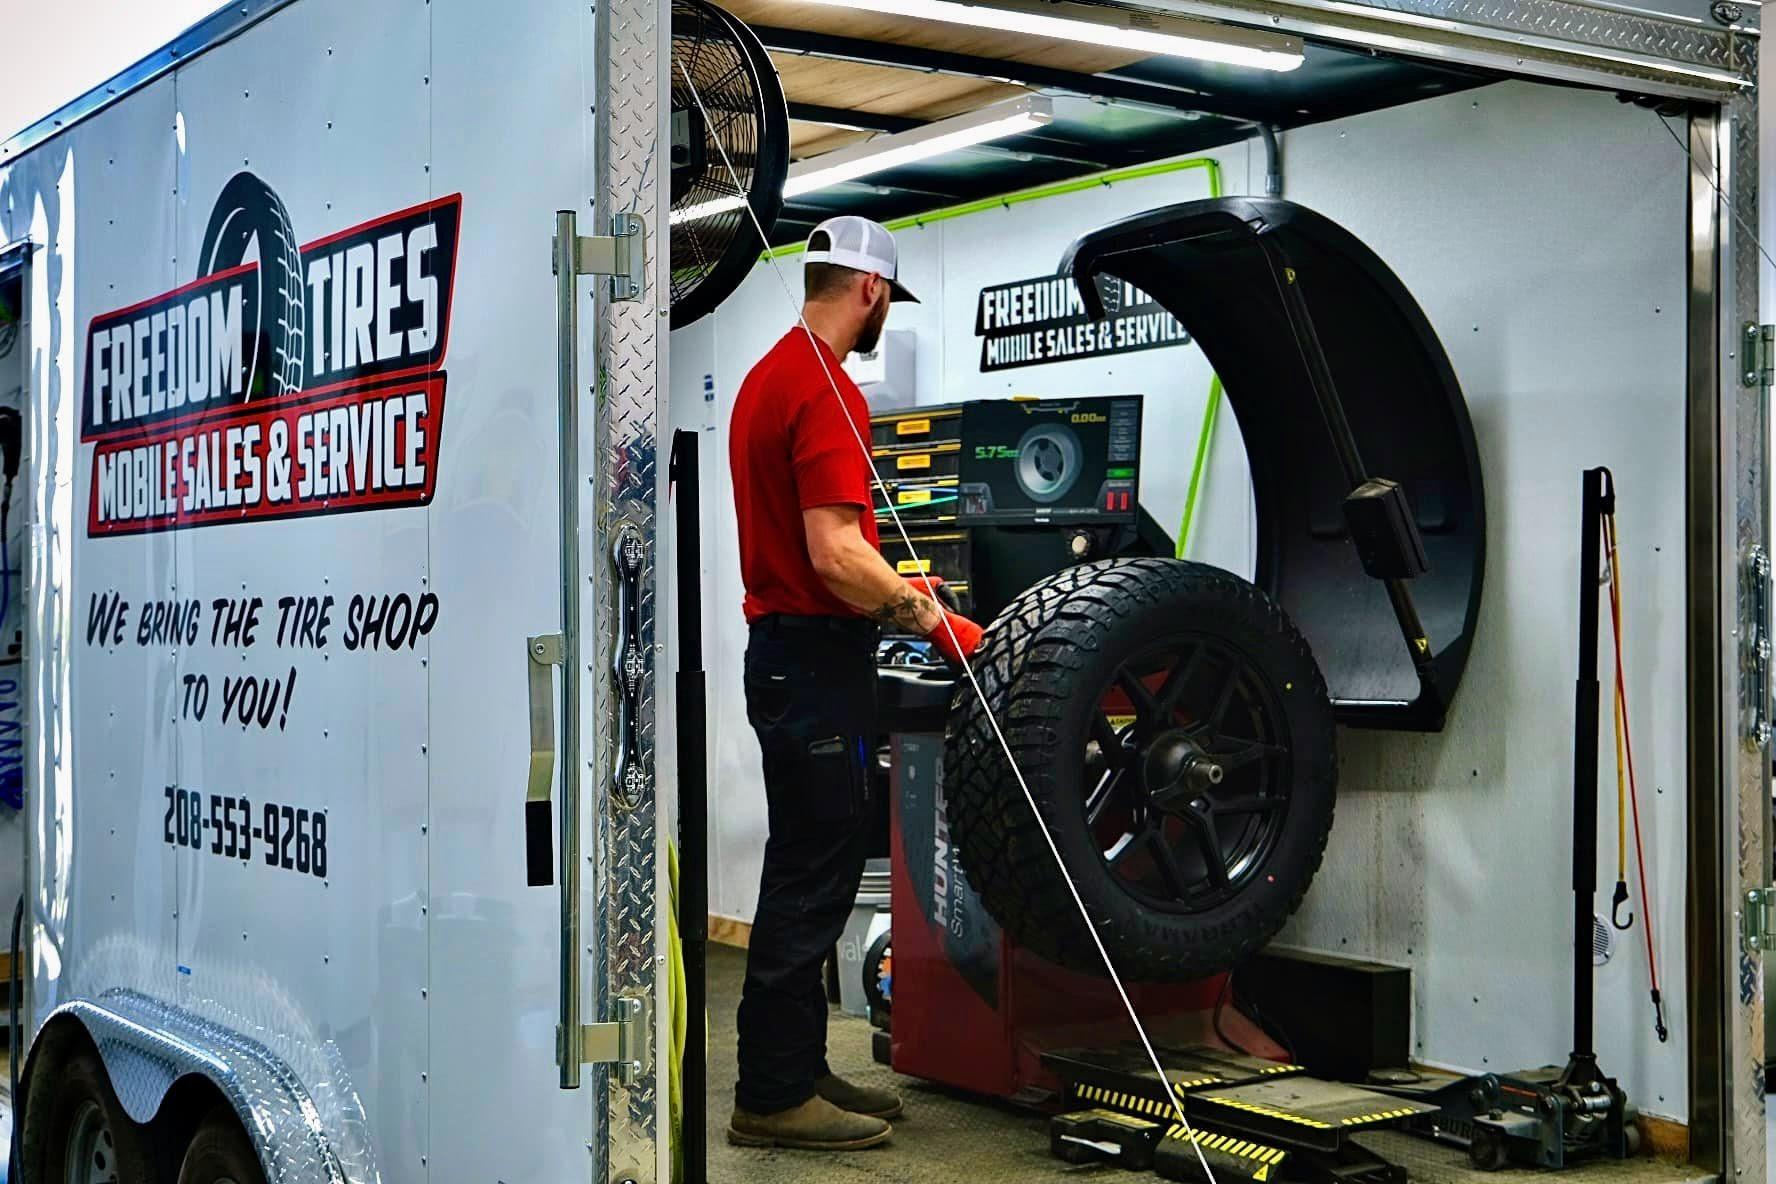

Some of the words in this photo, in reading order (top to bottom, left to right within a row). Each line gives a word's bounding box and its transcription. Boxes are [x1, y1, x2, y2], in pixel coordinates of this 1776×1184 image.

[91, 284, 243, 426] FREEDOM
[306, 222, 439, 377] TIRES
[983, 277, 1085, 330] FREEDOM
[986, 332, 1043, 366] MOBILE
[1046, 322, 1096, 357] SALES
[1098, 321, 1113, 350] &
[97, 440, 178, 522] MOBILE
[182, 424, 262, 512] SALES
[266, 419, 292, 501] &
[297, 393, 430, 498] SERVICE
[136, 599, 201, 647] BRING
[211, 597, 264, 648] THE
[276, 595, 335, 649] TIRE
[343, 592, 440, 652] SHOP
[183, 673, 209, 722] TO
[222, 666, 297, 731] YOU!
[163, 786, 328, 878] 208-553-9268
